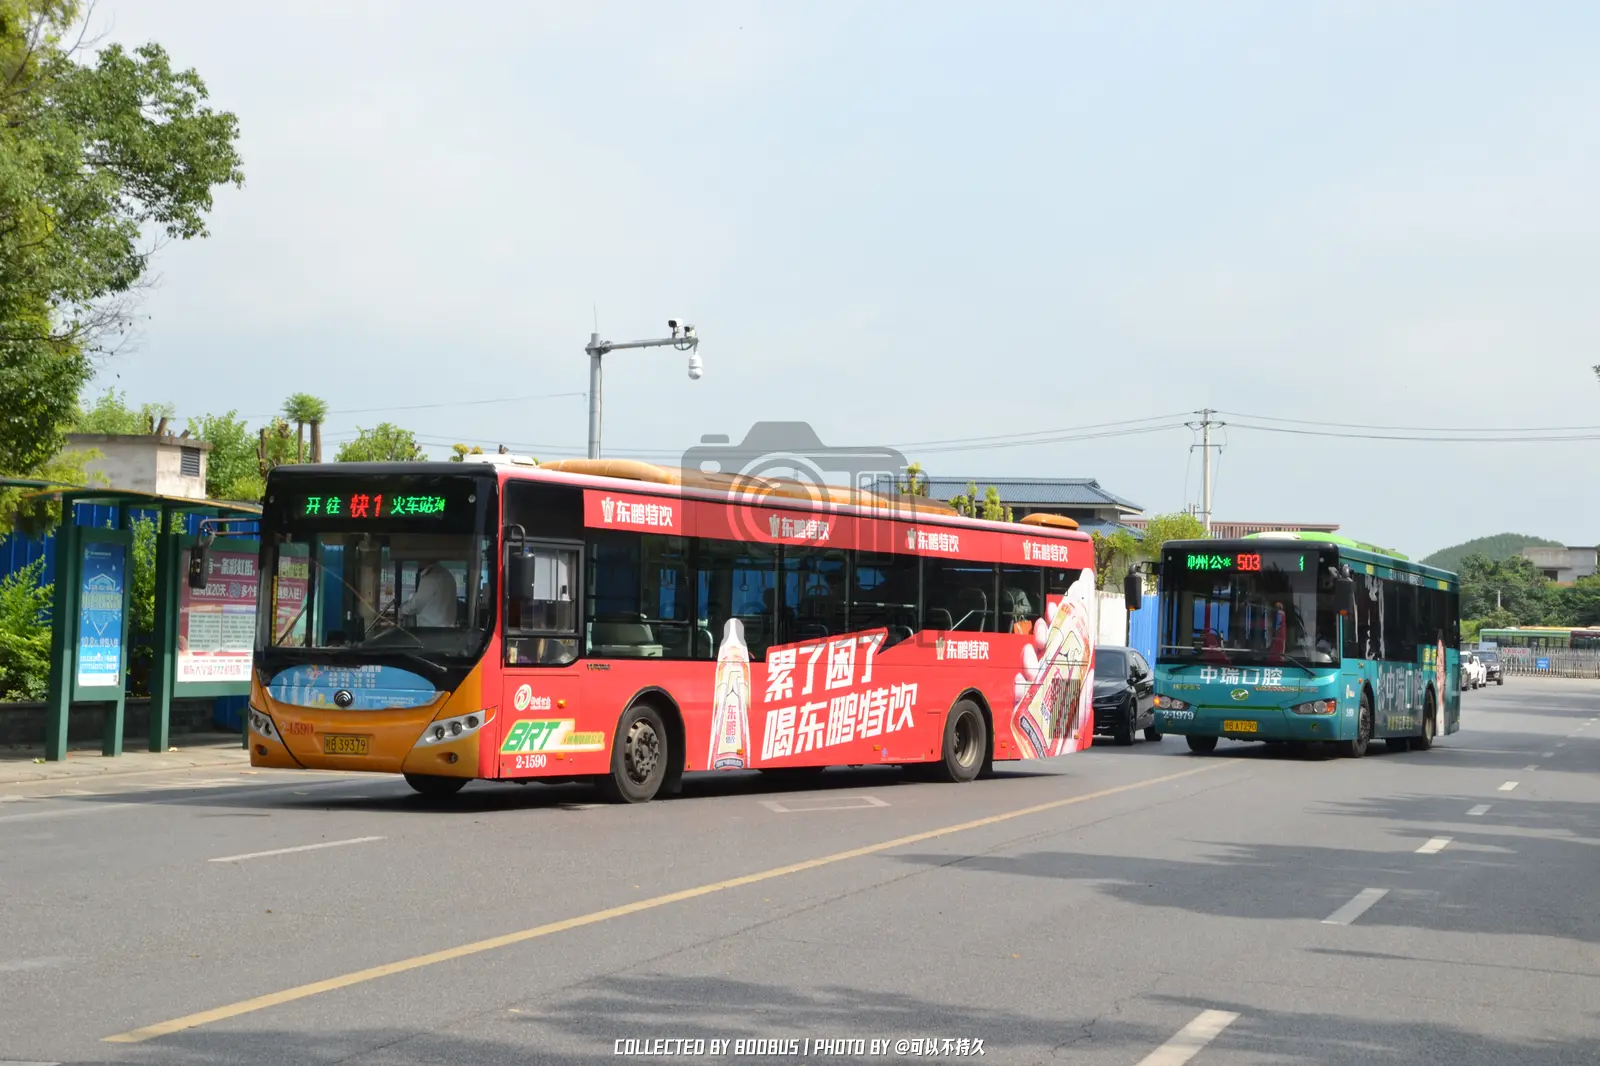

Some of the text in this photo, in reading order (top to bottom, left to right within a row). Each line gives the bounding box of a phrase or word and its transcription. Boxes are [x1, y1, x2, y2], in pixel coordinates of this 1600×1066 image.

[305, 496, 341, 514] 开往
[350, 494, 382, 517] 快1
[616, 500, 673, 527] 东鹏特饮
[781, 516, 830, 540] 东鹏特饮
[917, 530, 959, 552] 东鹏特饮
[1032, 541, 1069, 562] 东鹏特饮
[1237, 554, 1261, 571] 503
[946, 639, 989, 660] 东鹏特饮
[764, 632, 885, 703] 累了困了
[1200, 665, 1283, 686] 中瑞口腔
[761, 682, 918, 761] 喝东鹏特饮
[1163, 710, 1194, 720] 2-1979
[501, 721, 562, 751] BRT
[516, 754, 547, 769] 2-1590
